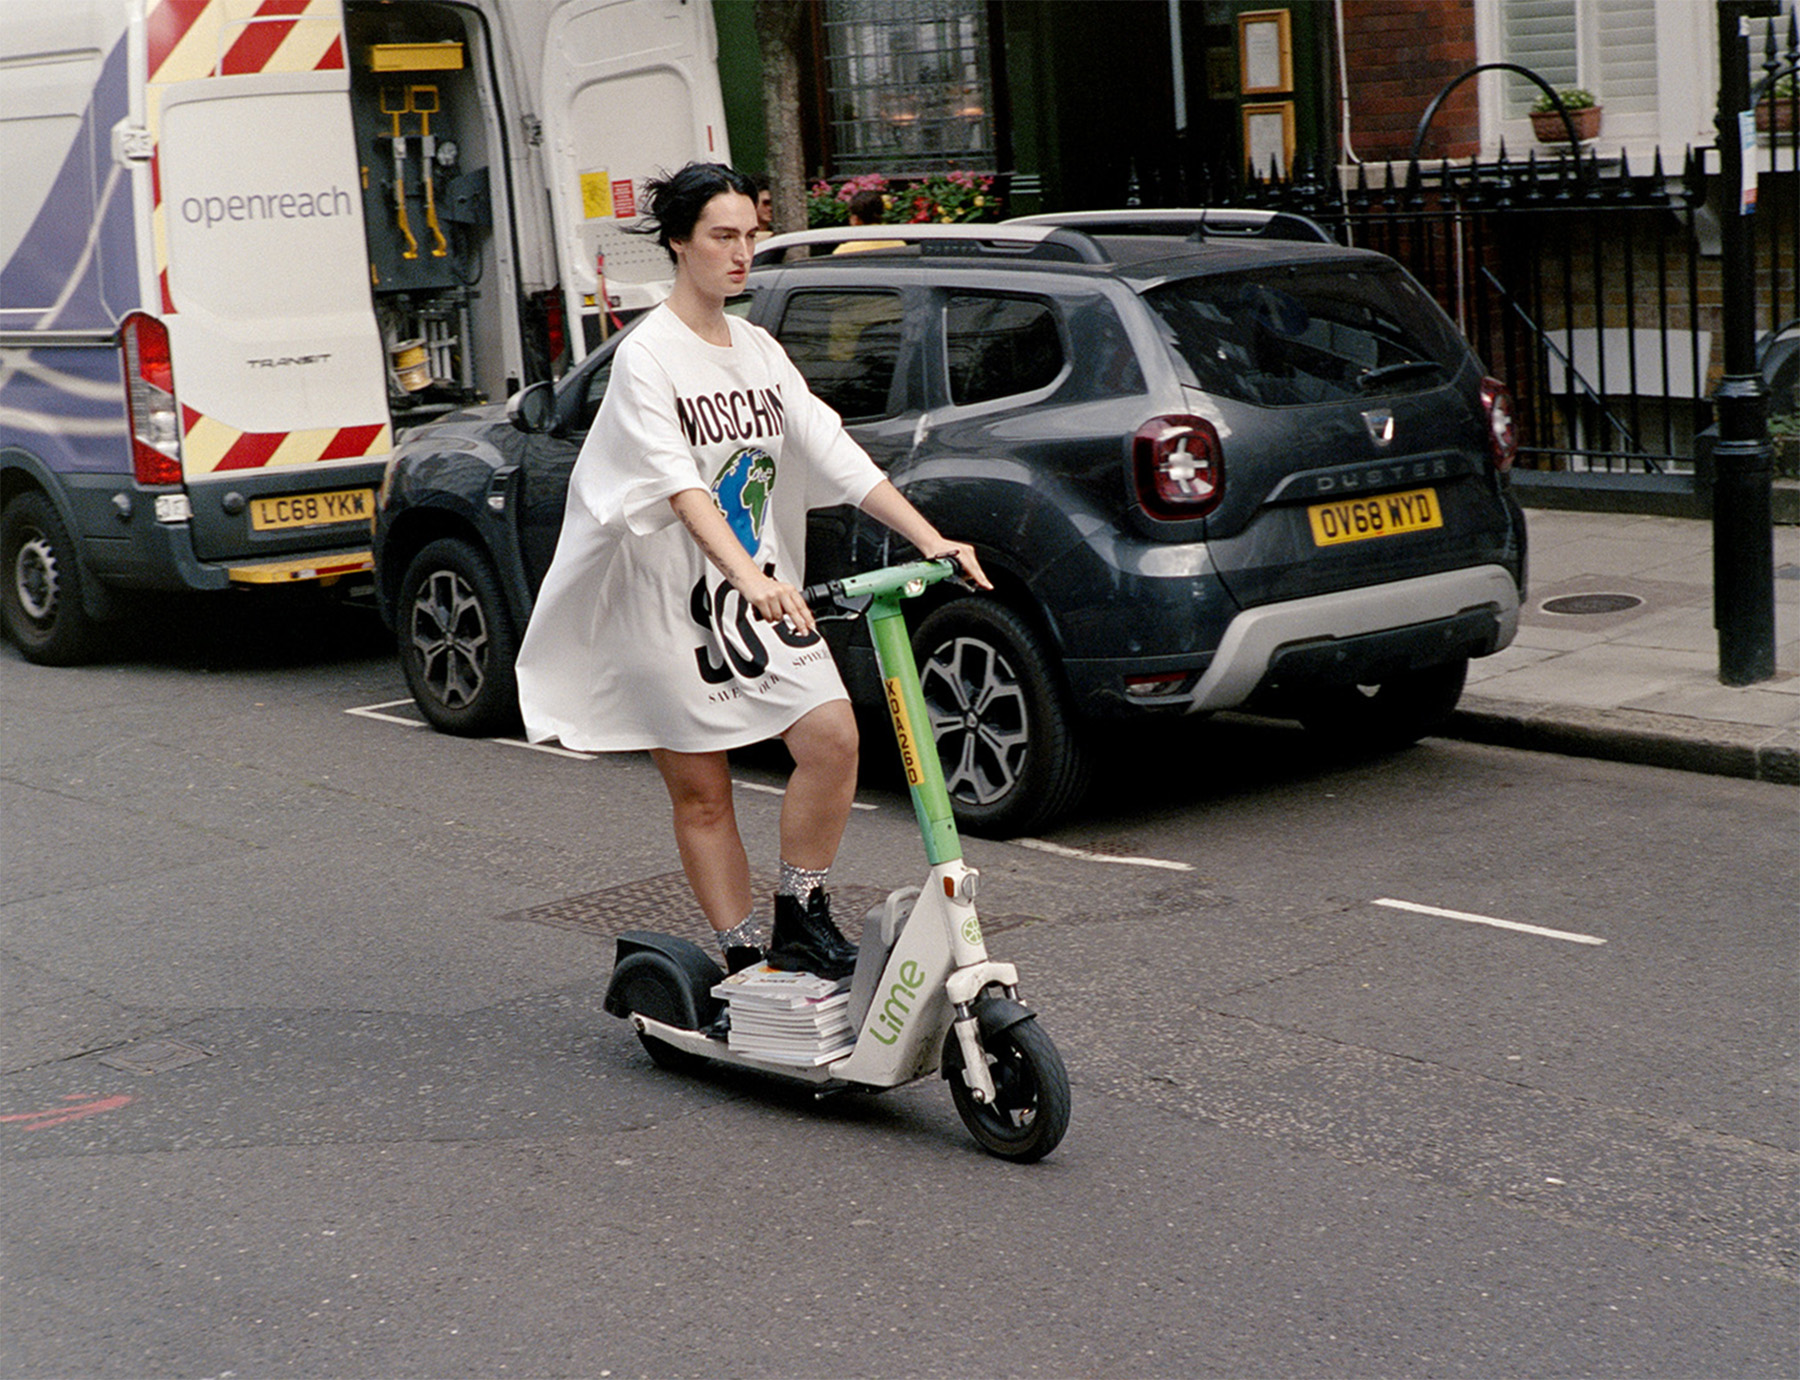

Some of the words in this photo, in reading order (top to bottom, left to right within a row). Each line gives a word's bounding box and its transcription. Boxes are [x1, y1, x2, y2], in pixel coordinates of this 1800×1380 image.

[181, 185, 352, 229] openreach
[1316, 459, 1447, 491] DUSTER
[260, 497, 319, 524] LC68
[323, 492, 366, 517] YKW
[1320, 501, 1384, 538] OV68
[1386, 494, 1432, 527] WYD
[758, 673, 780, 695] OUR
